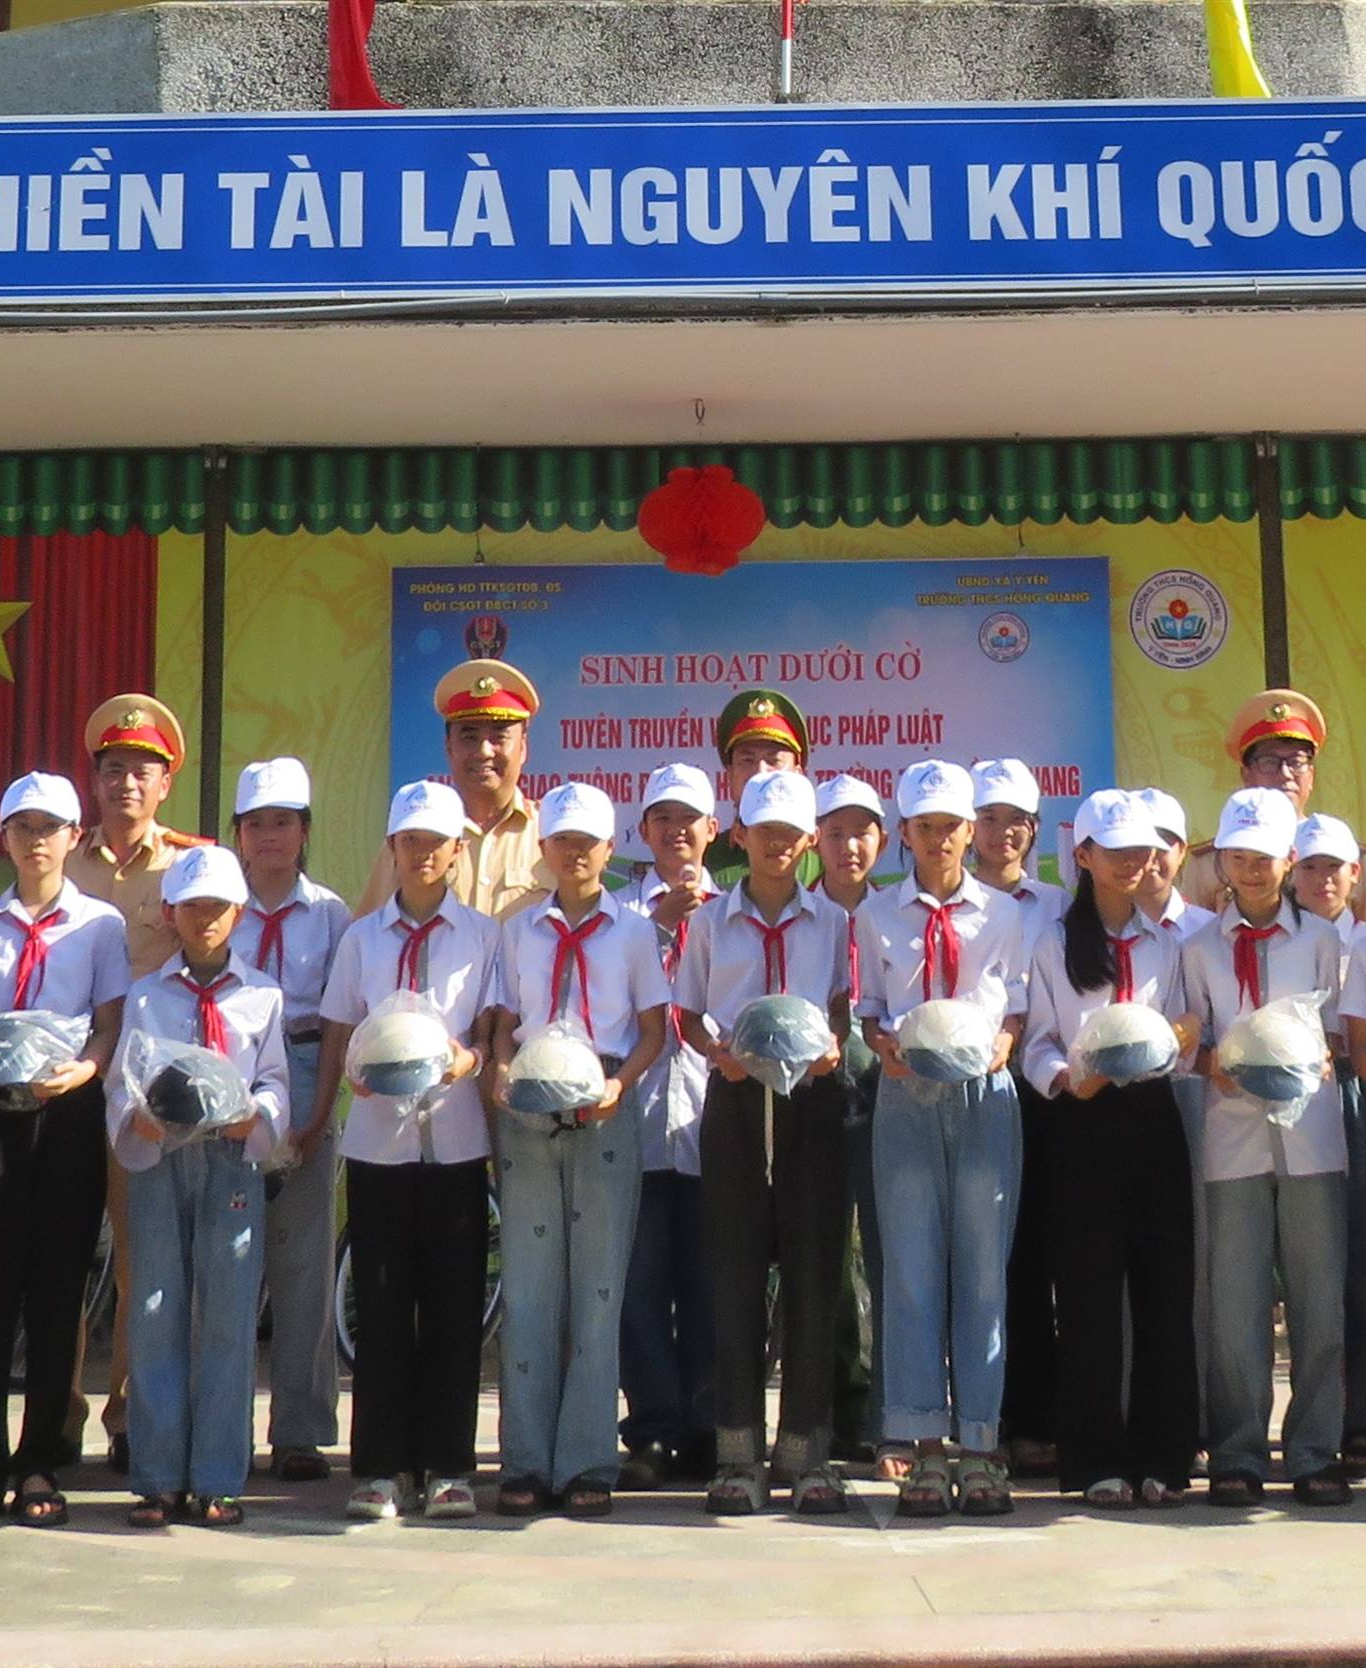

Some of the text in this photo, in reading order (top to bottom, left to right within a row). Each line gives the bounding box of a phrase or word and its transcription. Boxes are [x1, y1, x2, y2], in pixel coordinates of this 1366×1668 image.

[218, 154, 364, 250] TÀI
[401, 153, 515, 248] LÀ
[548, 149, 933, 246] NGUYÊN
[967, 146, 1123, 241] KHÍ
[1044, 591, 1091, 603] QUANG
[581, 641, 921, 689] SINH HOẠT DƯỚI CỜ
[560, 712, 622, 749] TUYÊN
[629, 707, 704, 748] TRUYỀN
[806, 715, 832, 752] ỤC
[838, 709, 891, 746] PHÁP
[897, 708, 944, 751] LUẬT
[1032, 764, 1082, 797] ANG
